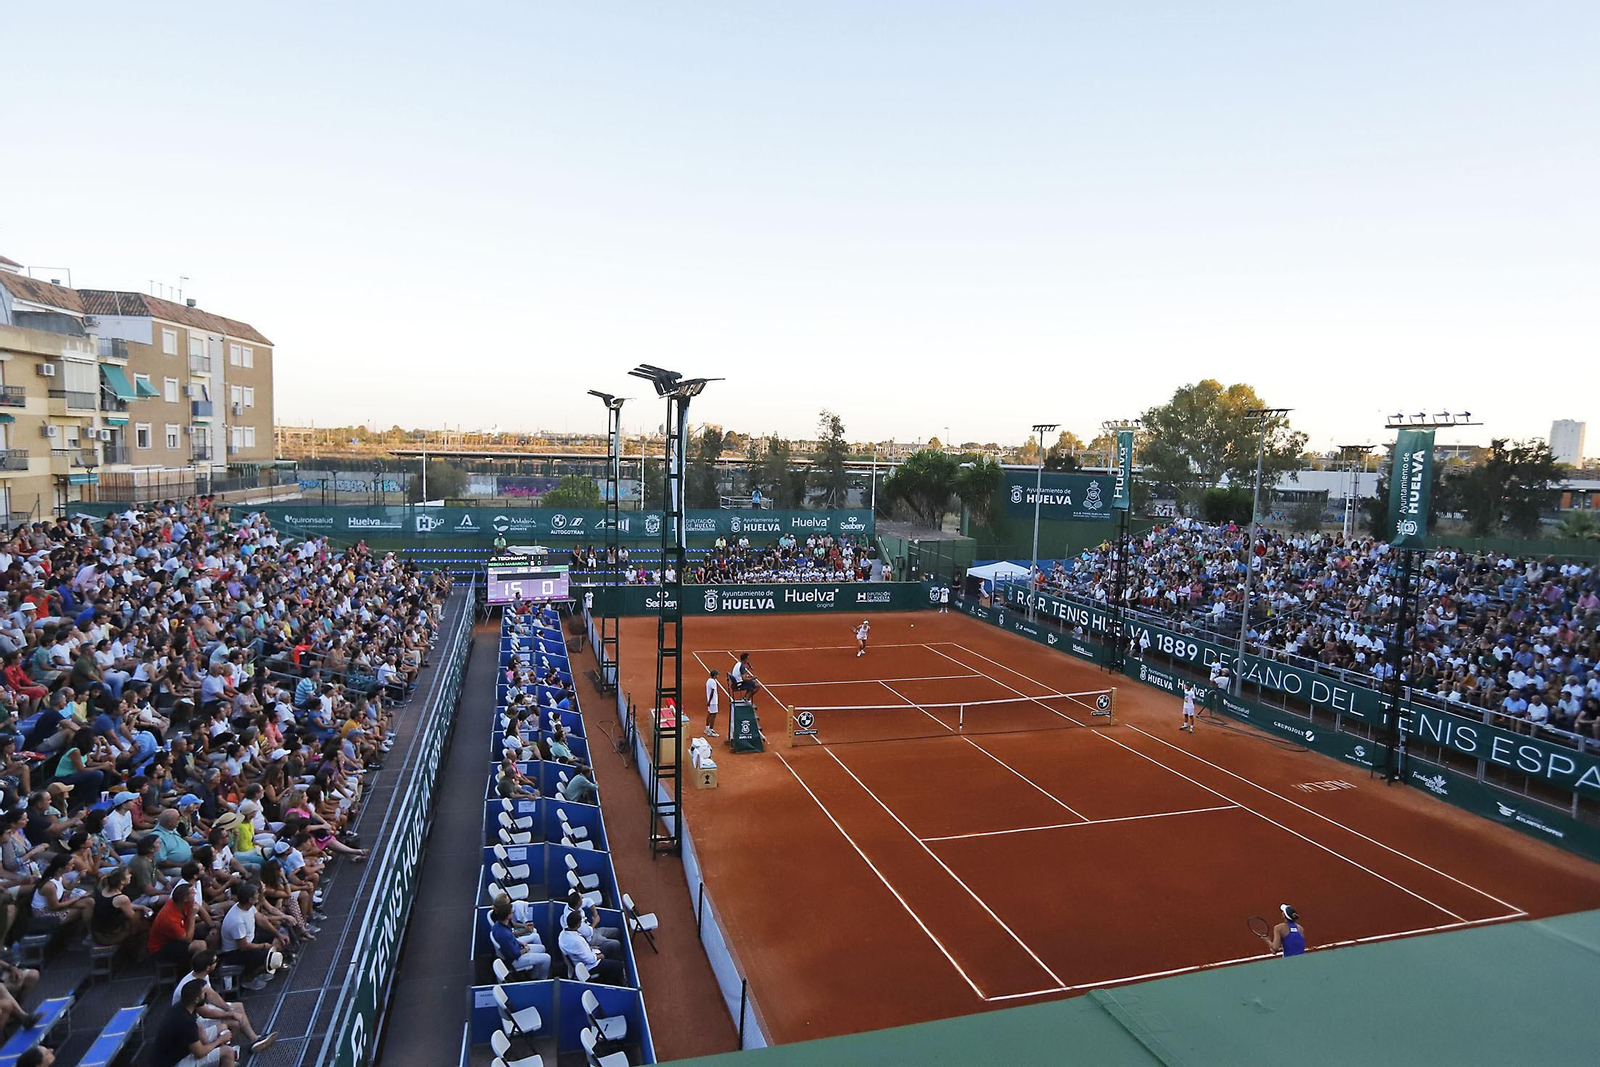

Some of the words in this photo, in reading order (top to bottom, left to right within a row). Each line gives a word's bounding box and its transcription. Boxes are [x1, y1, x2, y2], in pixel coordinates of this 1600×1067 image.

[1403, 452, 1410, 462] de
[1114, 447, 1126, 498] Huelva
[1399, 463, 1408, 514] Ayuntamiento
[1408, 450, 1426, 514] HUELVA
[1026, 494, 1072, 505] HUELVA
[348, 517, 381, 526] Huelva
[743, 523, 781, 532] HUELVA
[791, 517, 827, 527] Huelva
[504, 581, 523, 597] 15
[542, 580, 554, 595] 0
[721, 590, 764, 598] Ayuntamiento
[784, 588, 835, 603] Huelva
[722, 598, 775, 610] HUELVA
[1147, 673, 1173, 691] HUELVA
[1177, 678, 1205, 698] Hlva
[1052, 601, 1088, 626] TENIS
[1156, 633, 1198, 661] 1889
[1203, 647, 1302, 694] DECANO
[1310, 680, 1364, 717] DEL
[1378, 700, 1478, 752] TENIS
[1491, 735, 1600, 788] ESPA
[369, 870, 404, 1010] TENIS
[402, 773, 431, 891] HUELVA
